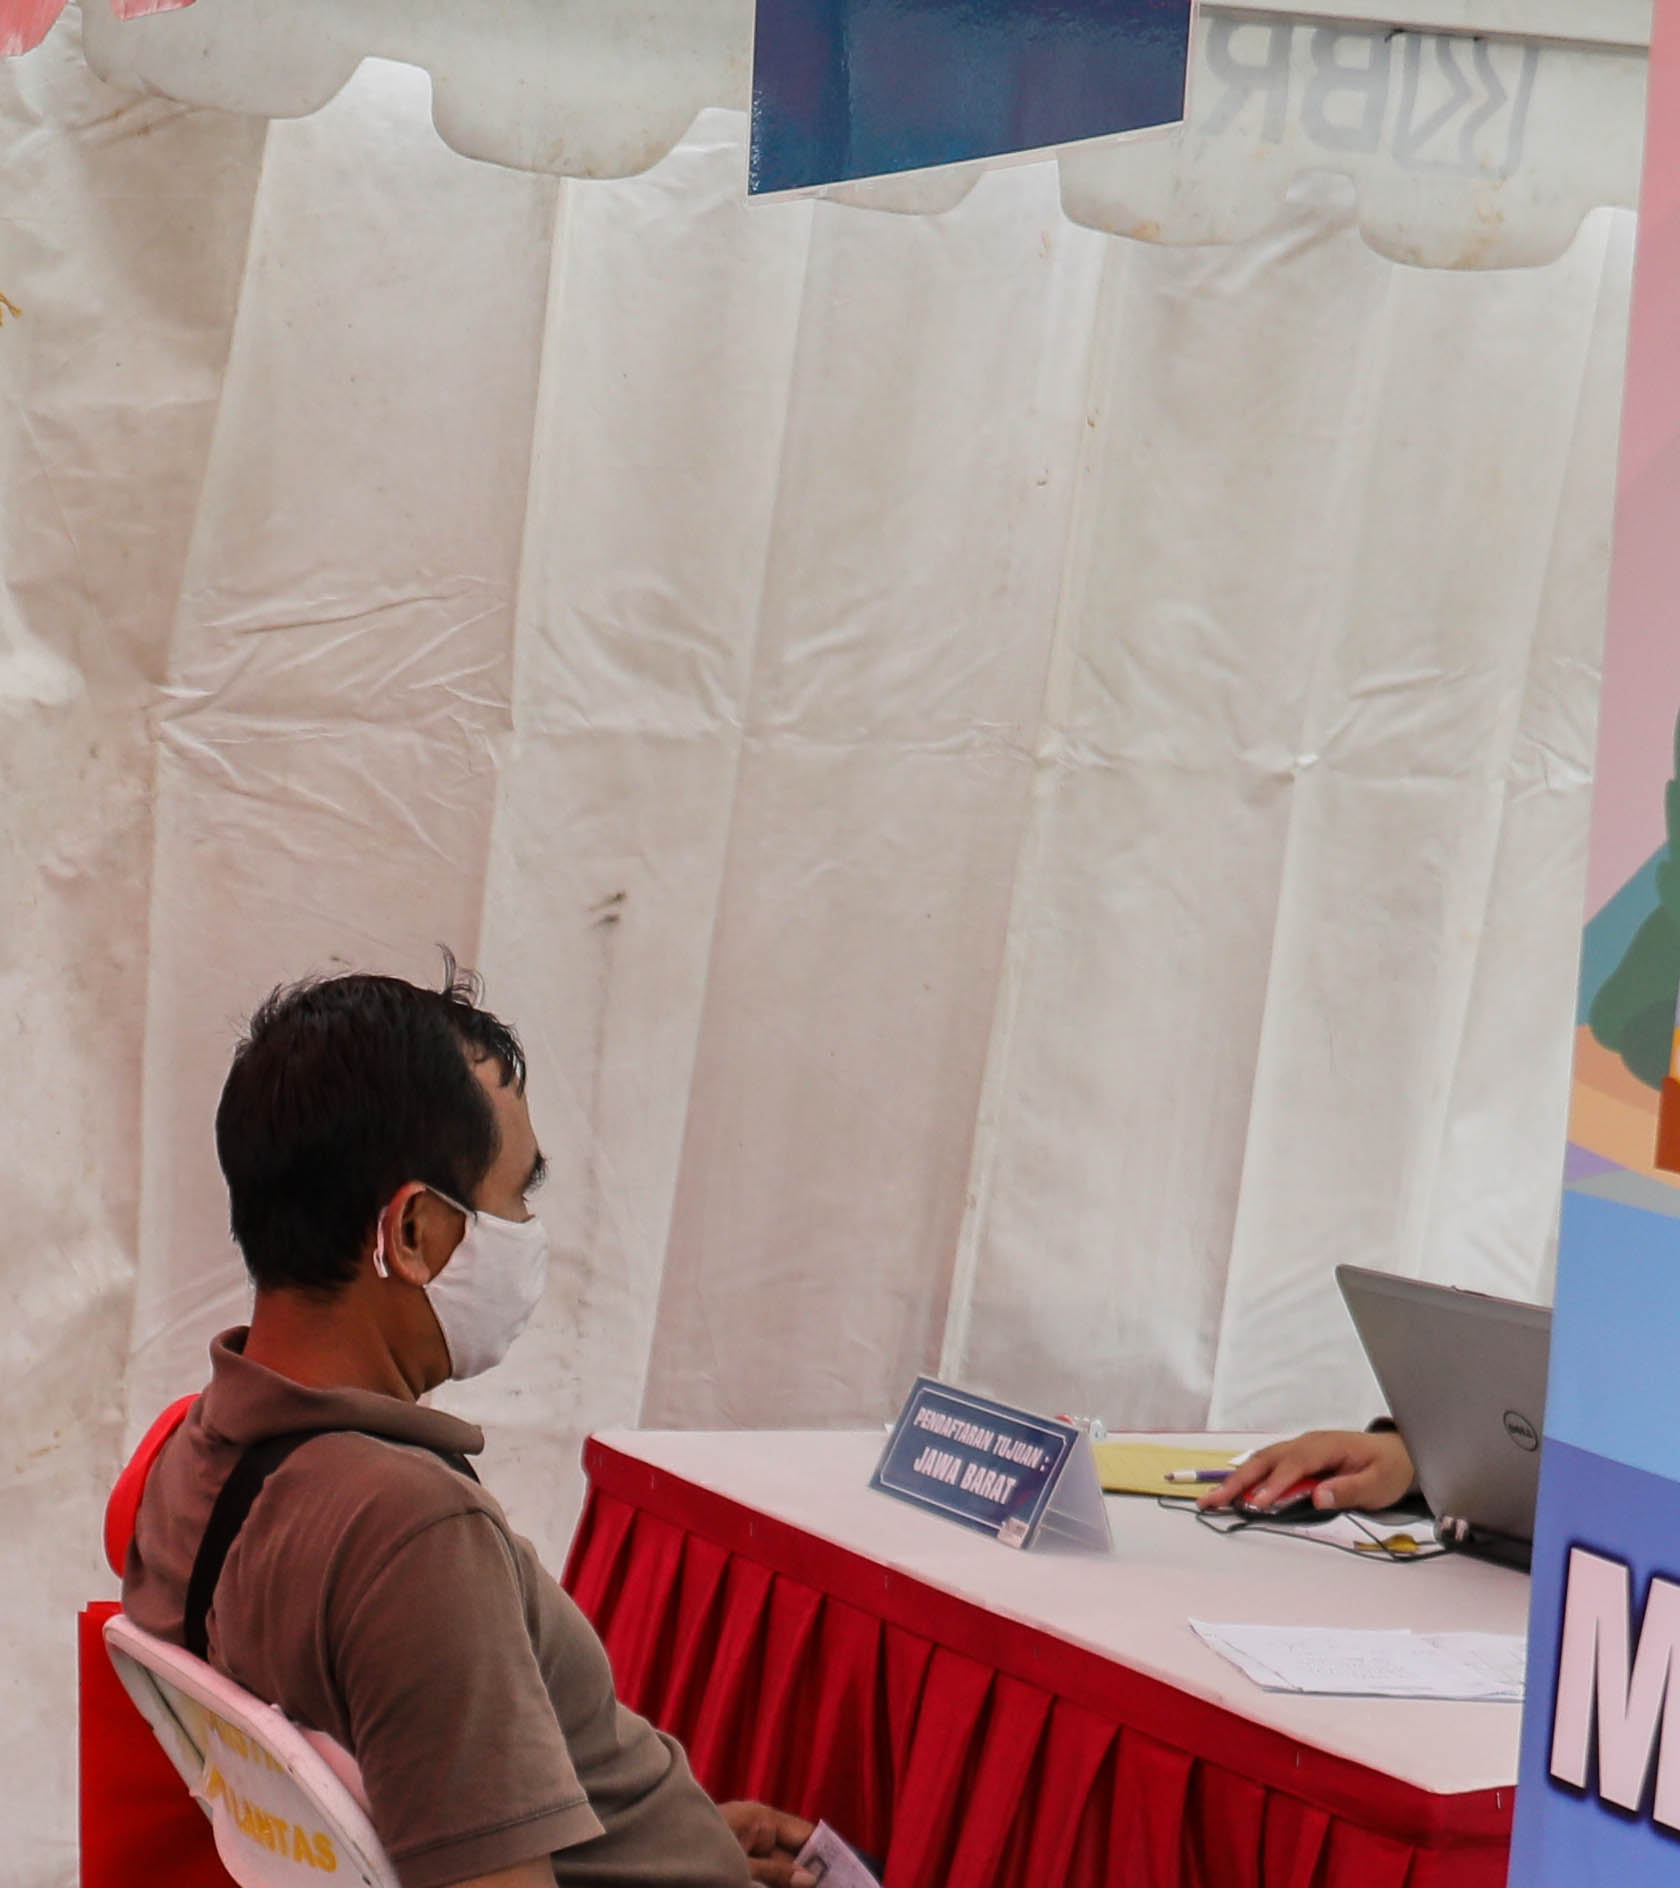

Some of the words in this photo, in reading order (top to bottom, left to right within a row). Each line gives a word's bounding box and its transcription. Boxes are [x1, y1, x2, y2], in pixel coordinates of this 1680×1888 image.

[912, 1406, 995, 1452] PENDAFTARAN
[993, 1434, 1044, 1469] TUJUAN
[912, 1446, 963, 1486] JAWA
[959, 1462, 1018, 1505] BARAT
